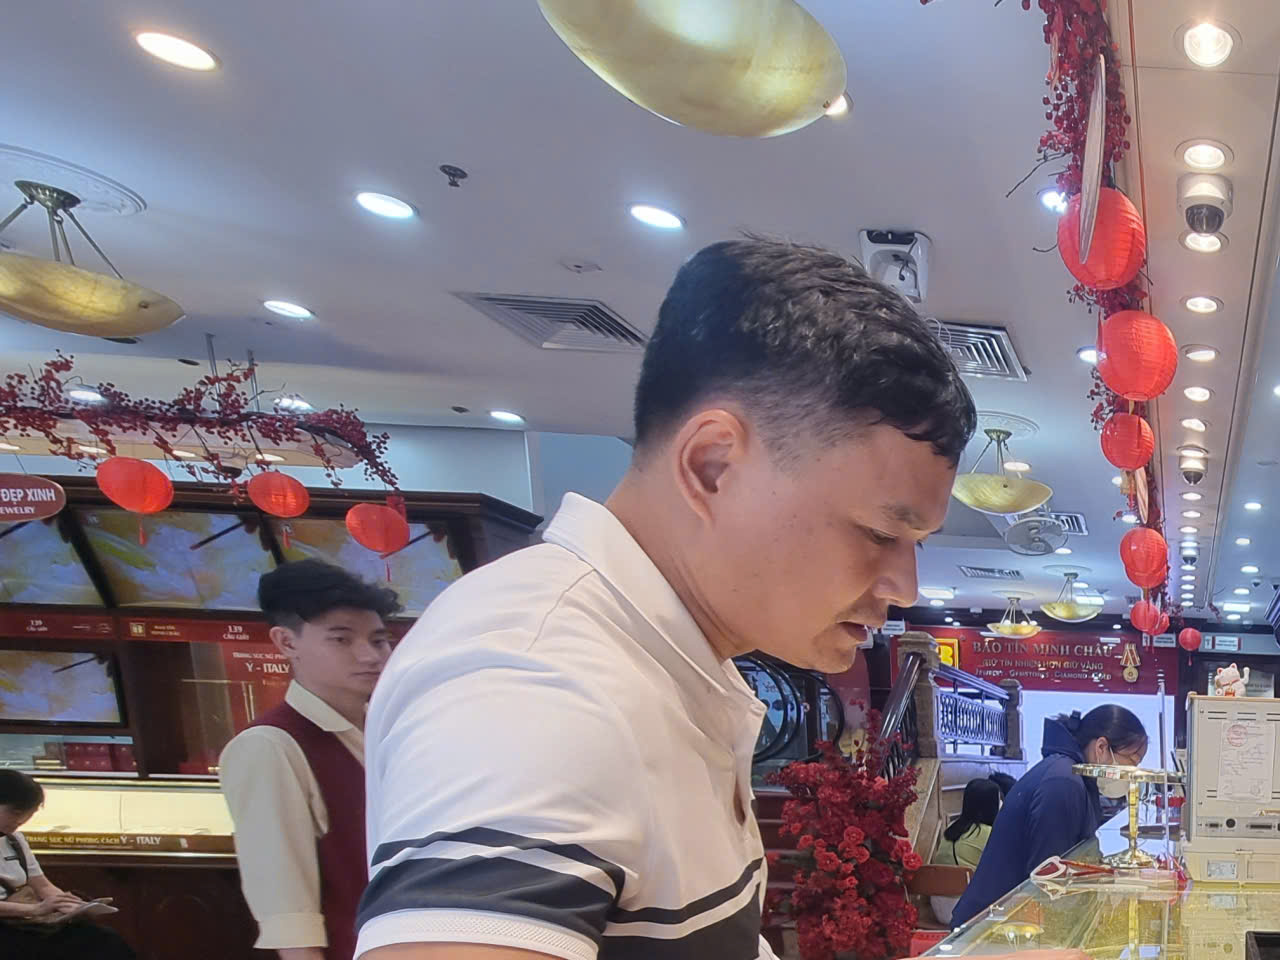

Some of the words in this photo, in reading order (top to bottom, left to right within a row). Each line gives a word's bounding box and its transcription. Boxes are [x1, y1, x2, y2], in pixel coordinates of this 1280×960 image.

[0, 488, 24, 505] ĐẸP
[26, 488, 56, 501] XINH
[0, 506, 35, 514] EWELRY
[1032, 643, 1070, 656] MINH
[263, 663, 290, 673] ITALY
[136, 836, 161, 845] ITALY
